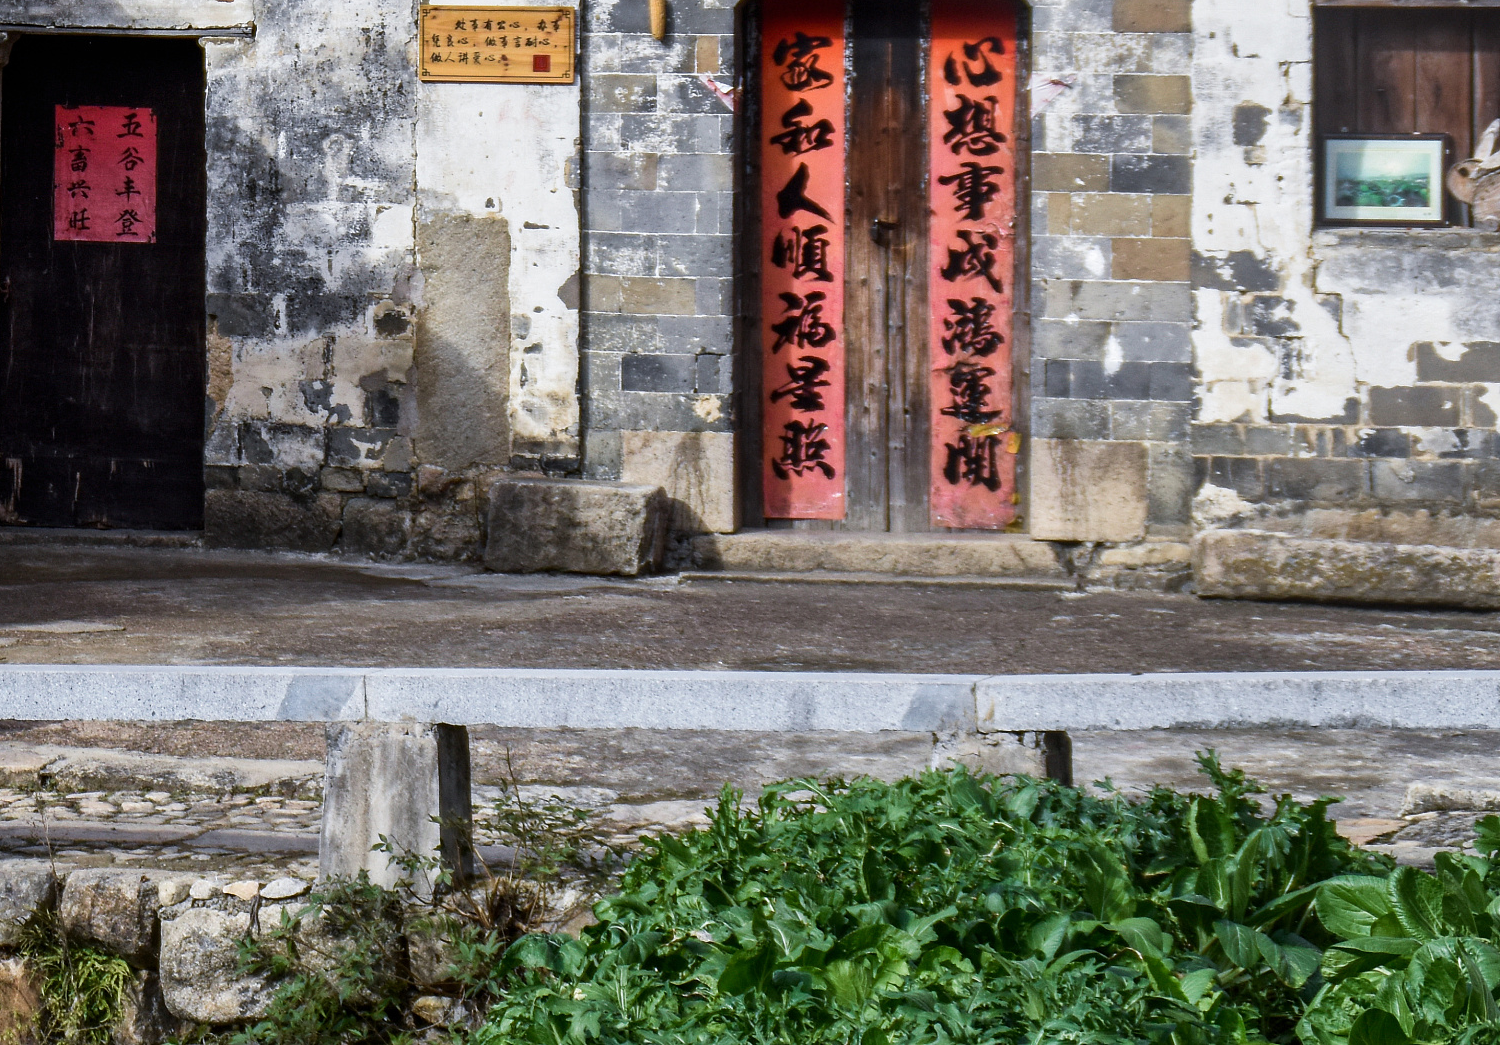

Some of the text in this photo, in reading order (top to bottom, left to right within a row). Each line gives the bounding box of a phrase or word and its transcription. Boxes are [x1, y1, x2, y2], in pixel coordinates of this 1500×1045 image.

[66, 115, 96, 231] 六畜兴旺
[115, 112, 145, 237] 五谷丰登
